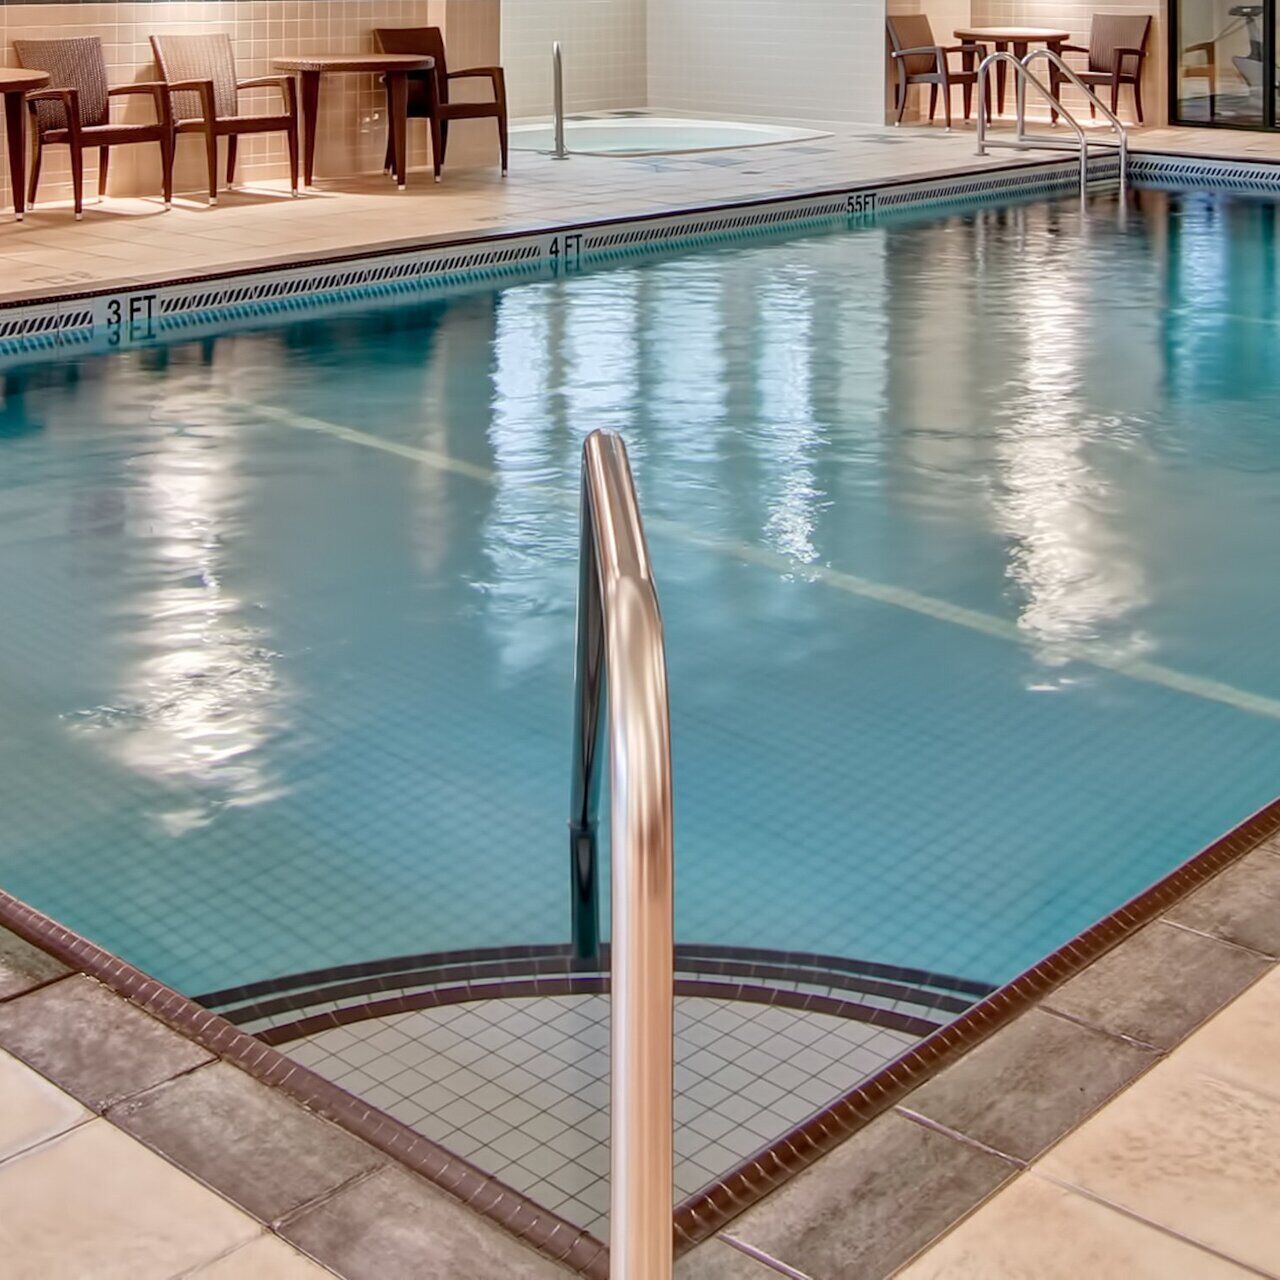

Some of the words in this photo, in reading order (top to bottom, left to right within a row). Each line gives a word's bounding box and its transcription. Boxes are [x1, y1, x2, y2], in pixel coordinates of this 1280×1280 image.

[549, 237, 560, 257] 4
[565, 234, 582, 256] FT
[107, 299, 121, 325] 3
[129, 294, 157, 322] FT
